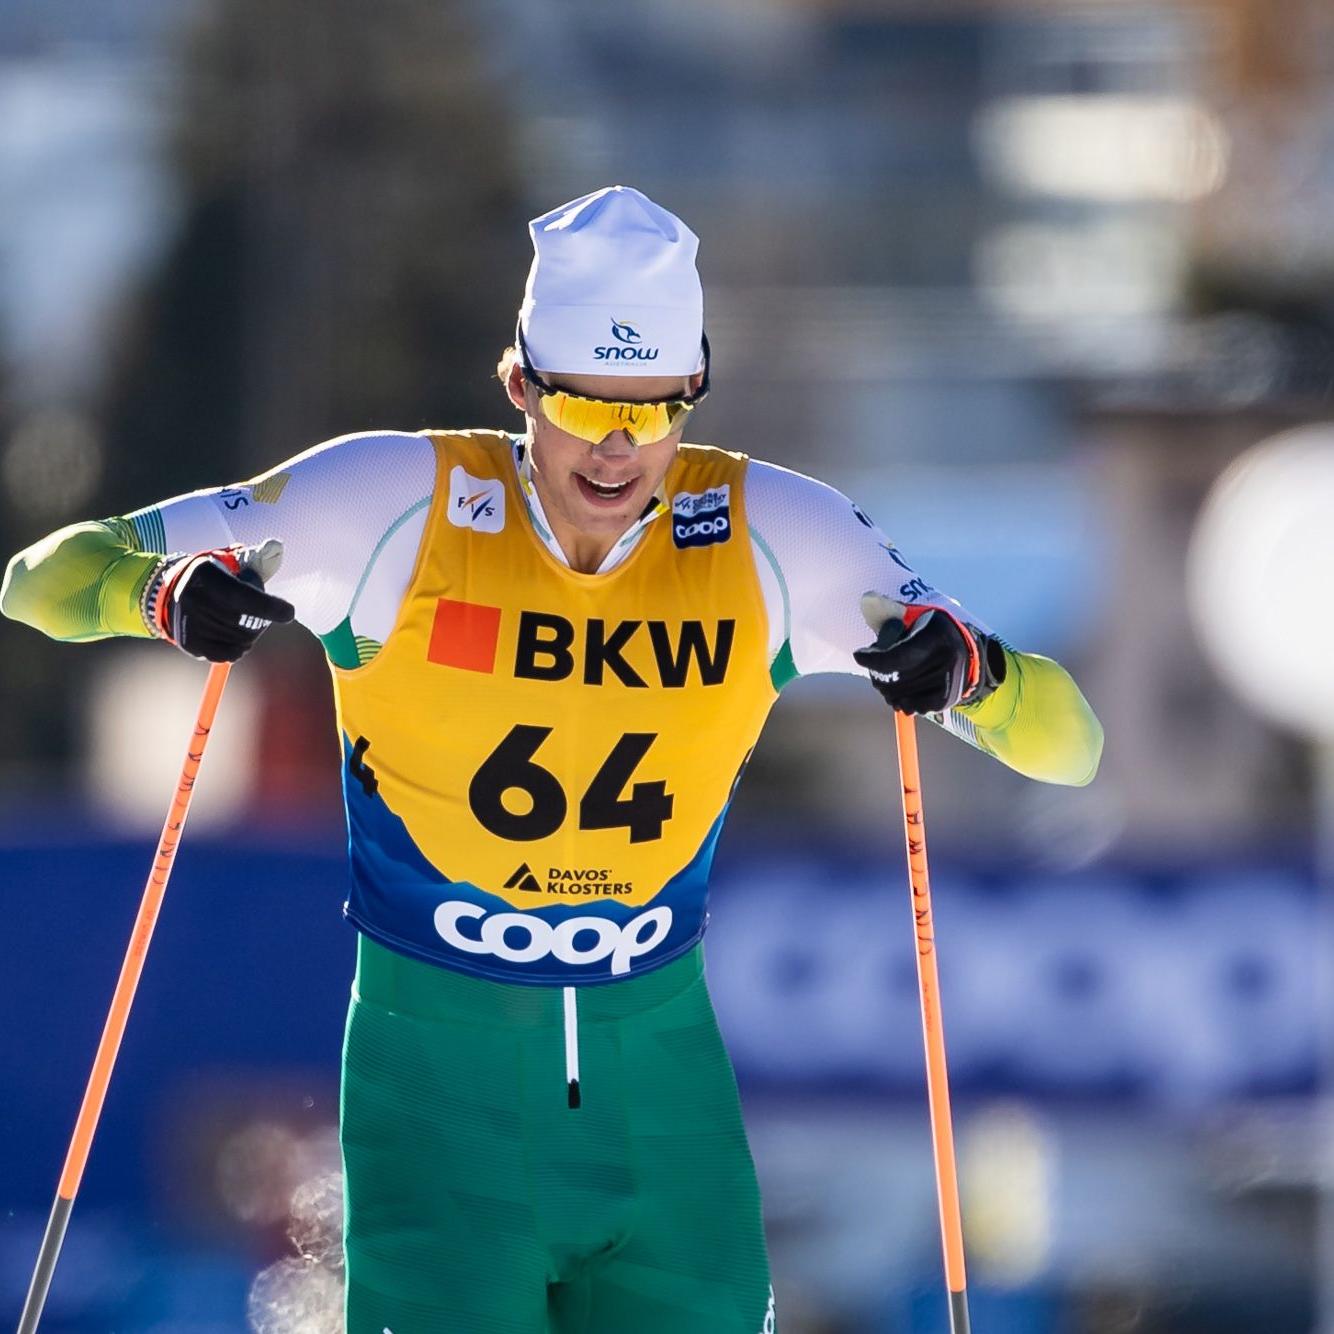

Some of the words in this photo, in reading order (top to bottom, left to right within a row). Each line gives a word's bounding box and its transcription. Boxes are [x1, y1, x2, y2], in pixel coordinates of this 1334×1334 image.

[593, 346, 659, 361] snow
[675, 516, 728, 539] coop
[513, 609, 737, 689] BKW
[468, 723, 675, 845] 64
[548, 867, 609, 881] DAVOS
[547, 881, 633, 895] KLOSTERS
[433, 900, 673, 976] coop
